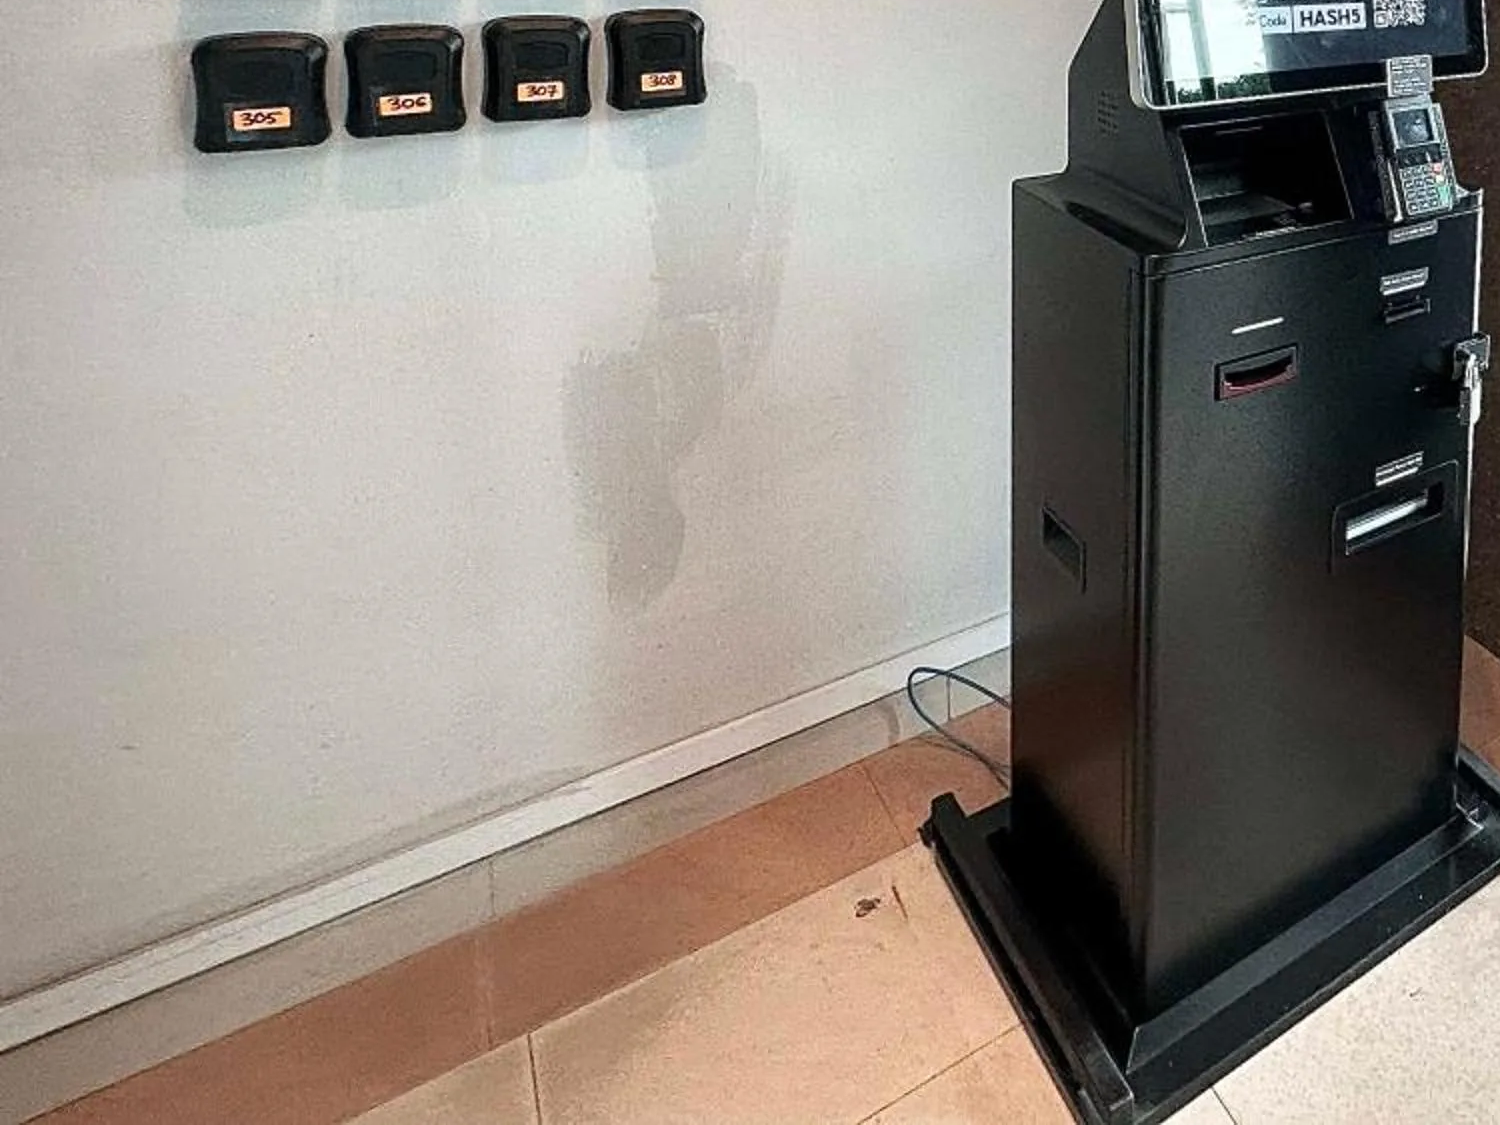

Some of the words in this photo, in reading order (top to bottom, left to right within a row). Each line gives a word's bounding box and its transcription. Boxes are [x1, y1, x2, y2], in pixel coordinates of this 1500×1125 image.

[1300, 8, 1361, 27] HASH5
[526, 84, 558, 98] 307
[389, 96, 427, 111] 306
[240, 110, 278, 126] 305
